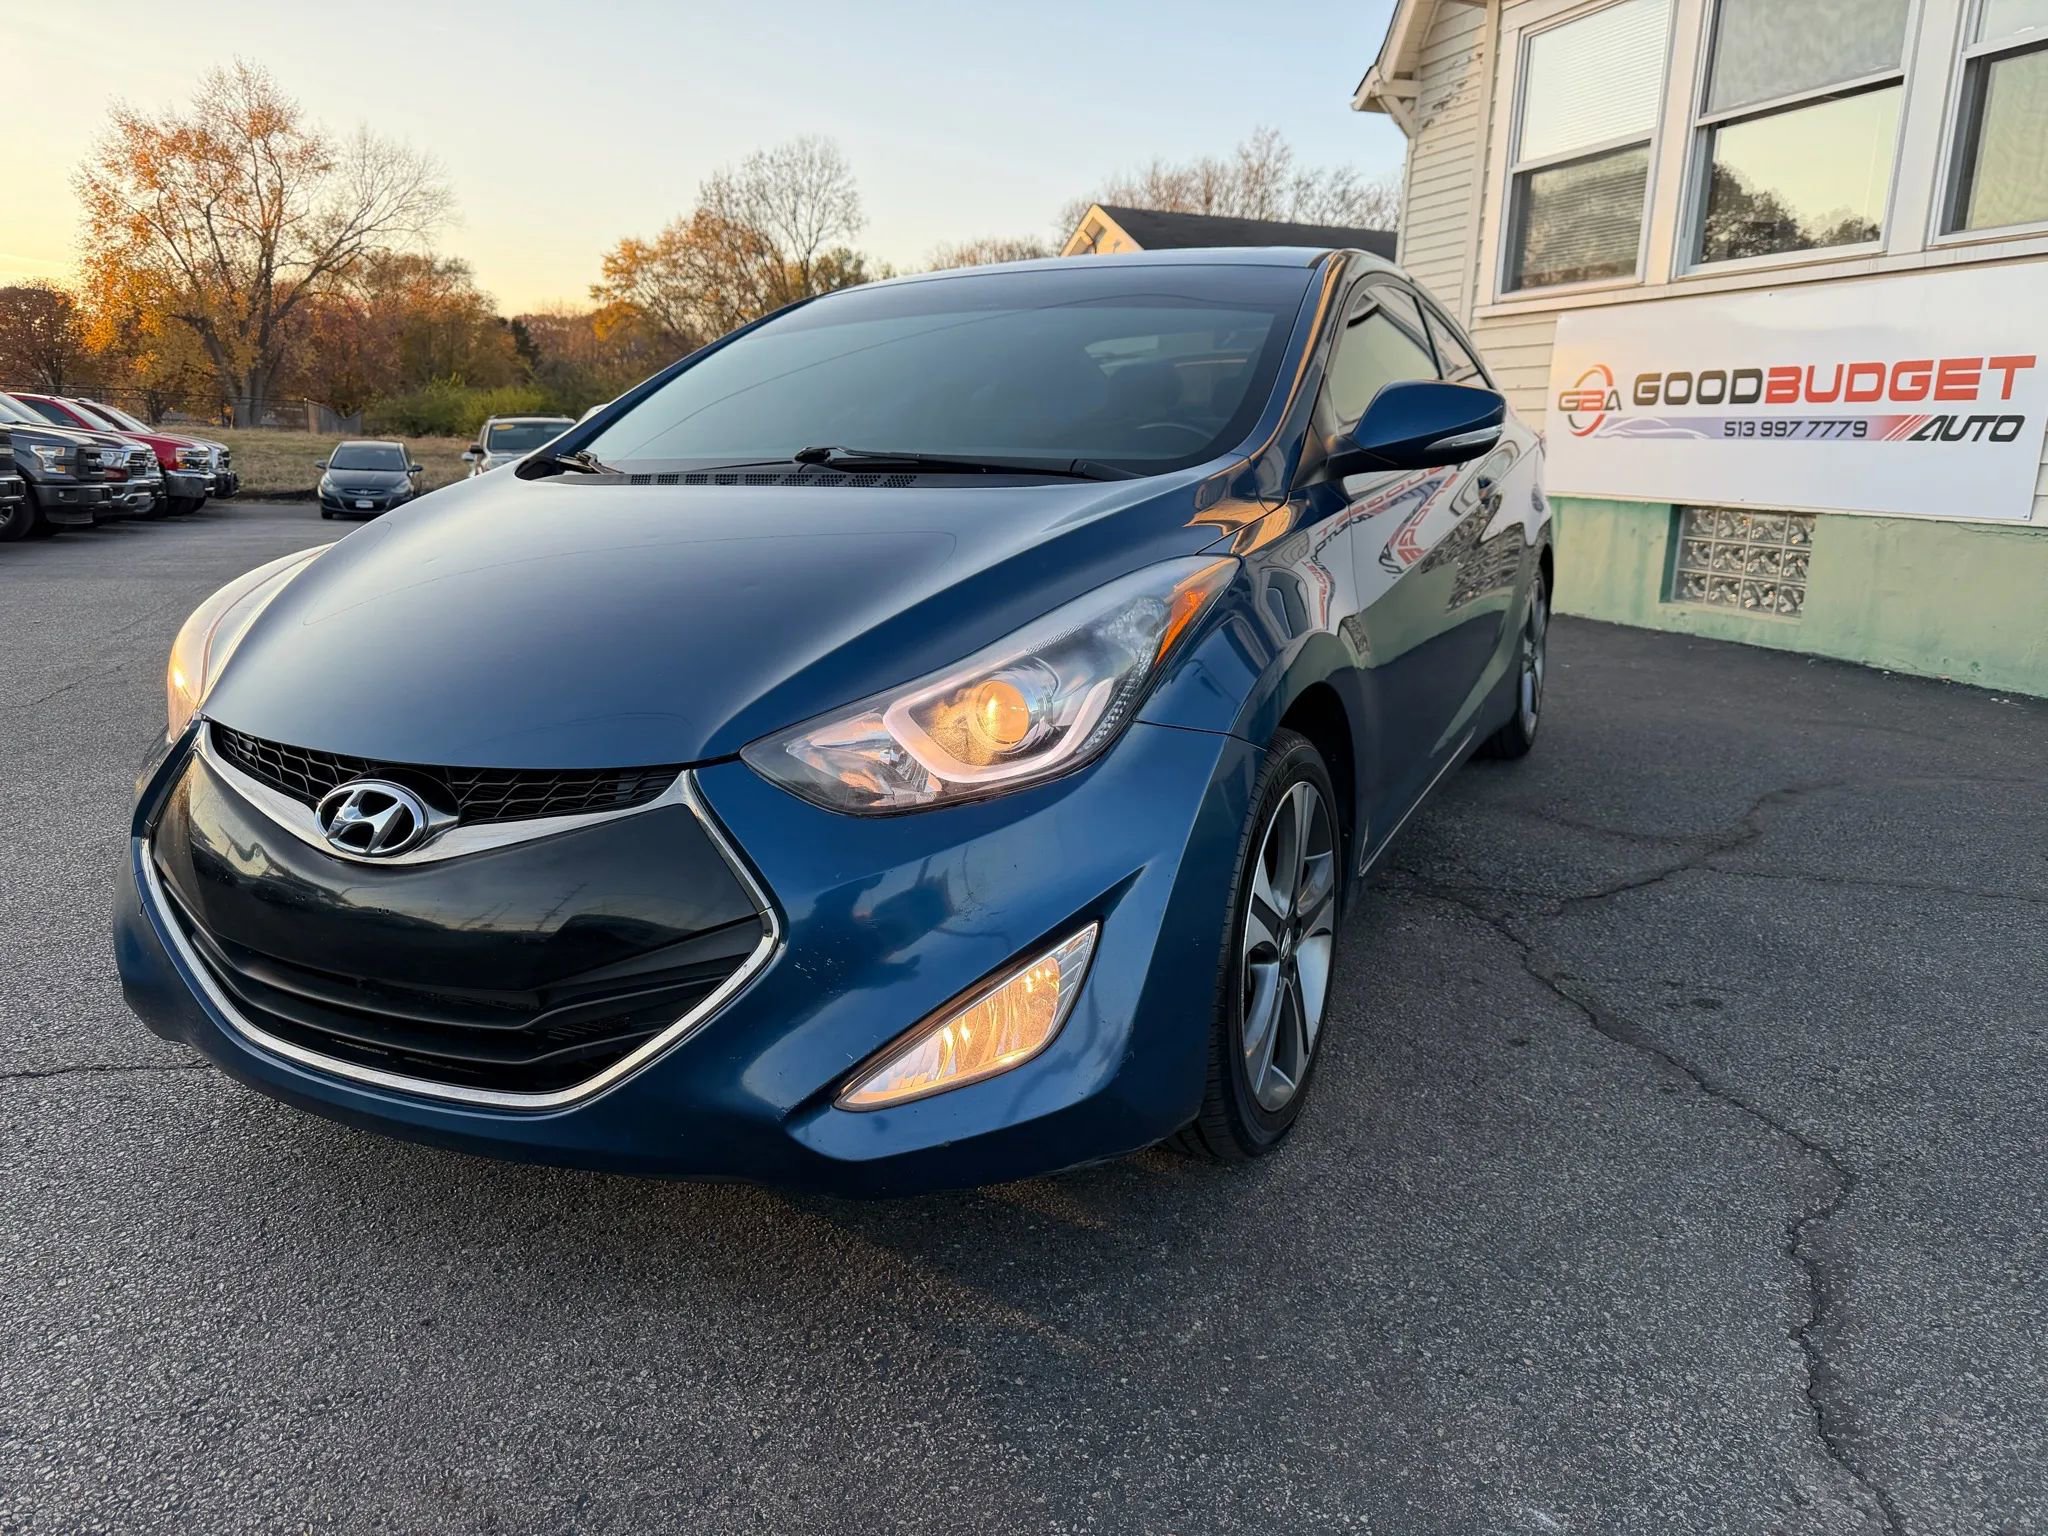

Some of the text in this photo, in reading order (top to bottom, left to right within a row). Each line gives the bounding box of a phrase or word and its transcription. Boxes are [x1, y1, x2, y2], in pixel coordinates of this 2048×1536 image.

[1558, 389, 1622, 411] GBA
[1723, 420, 1868, 438] 513 997 7779
[1907, 414, 2026, 443] AUTO
